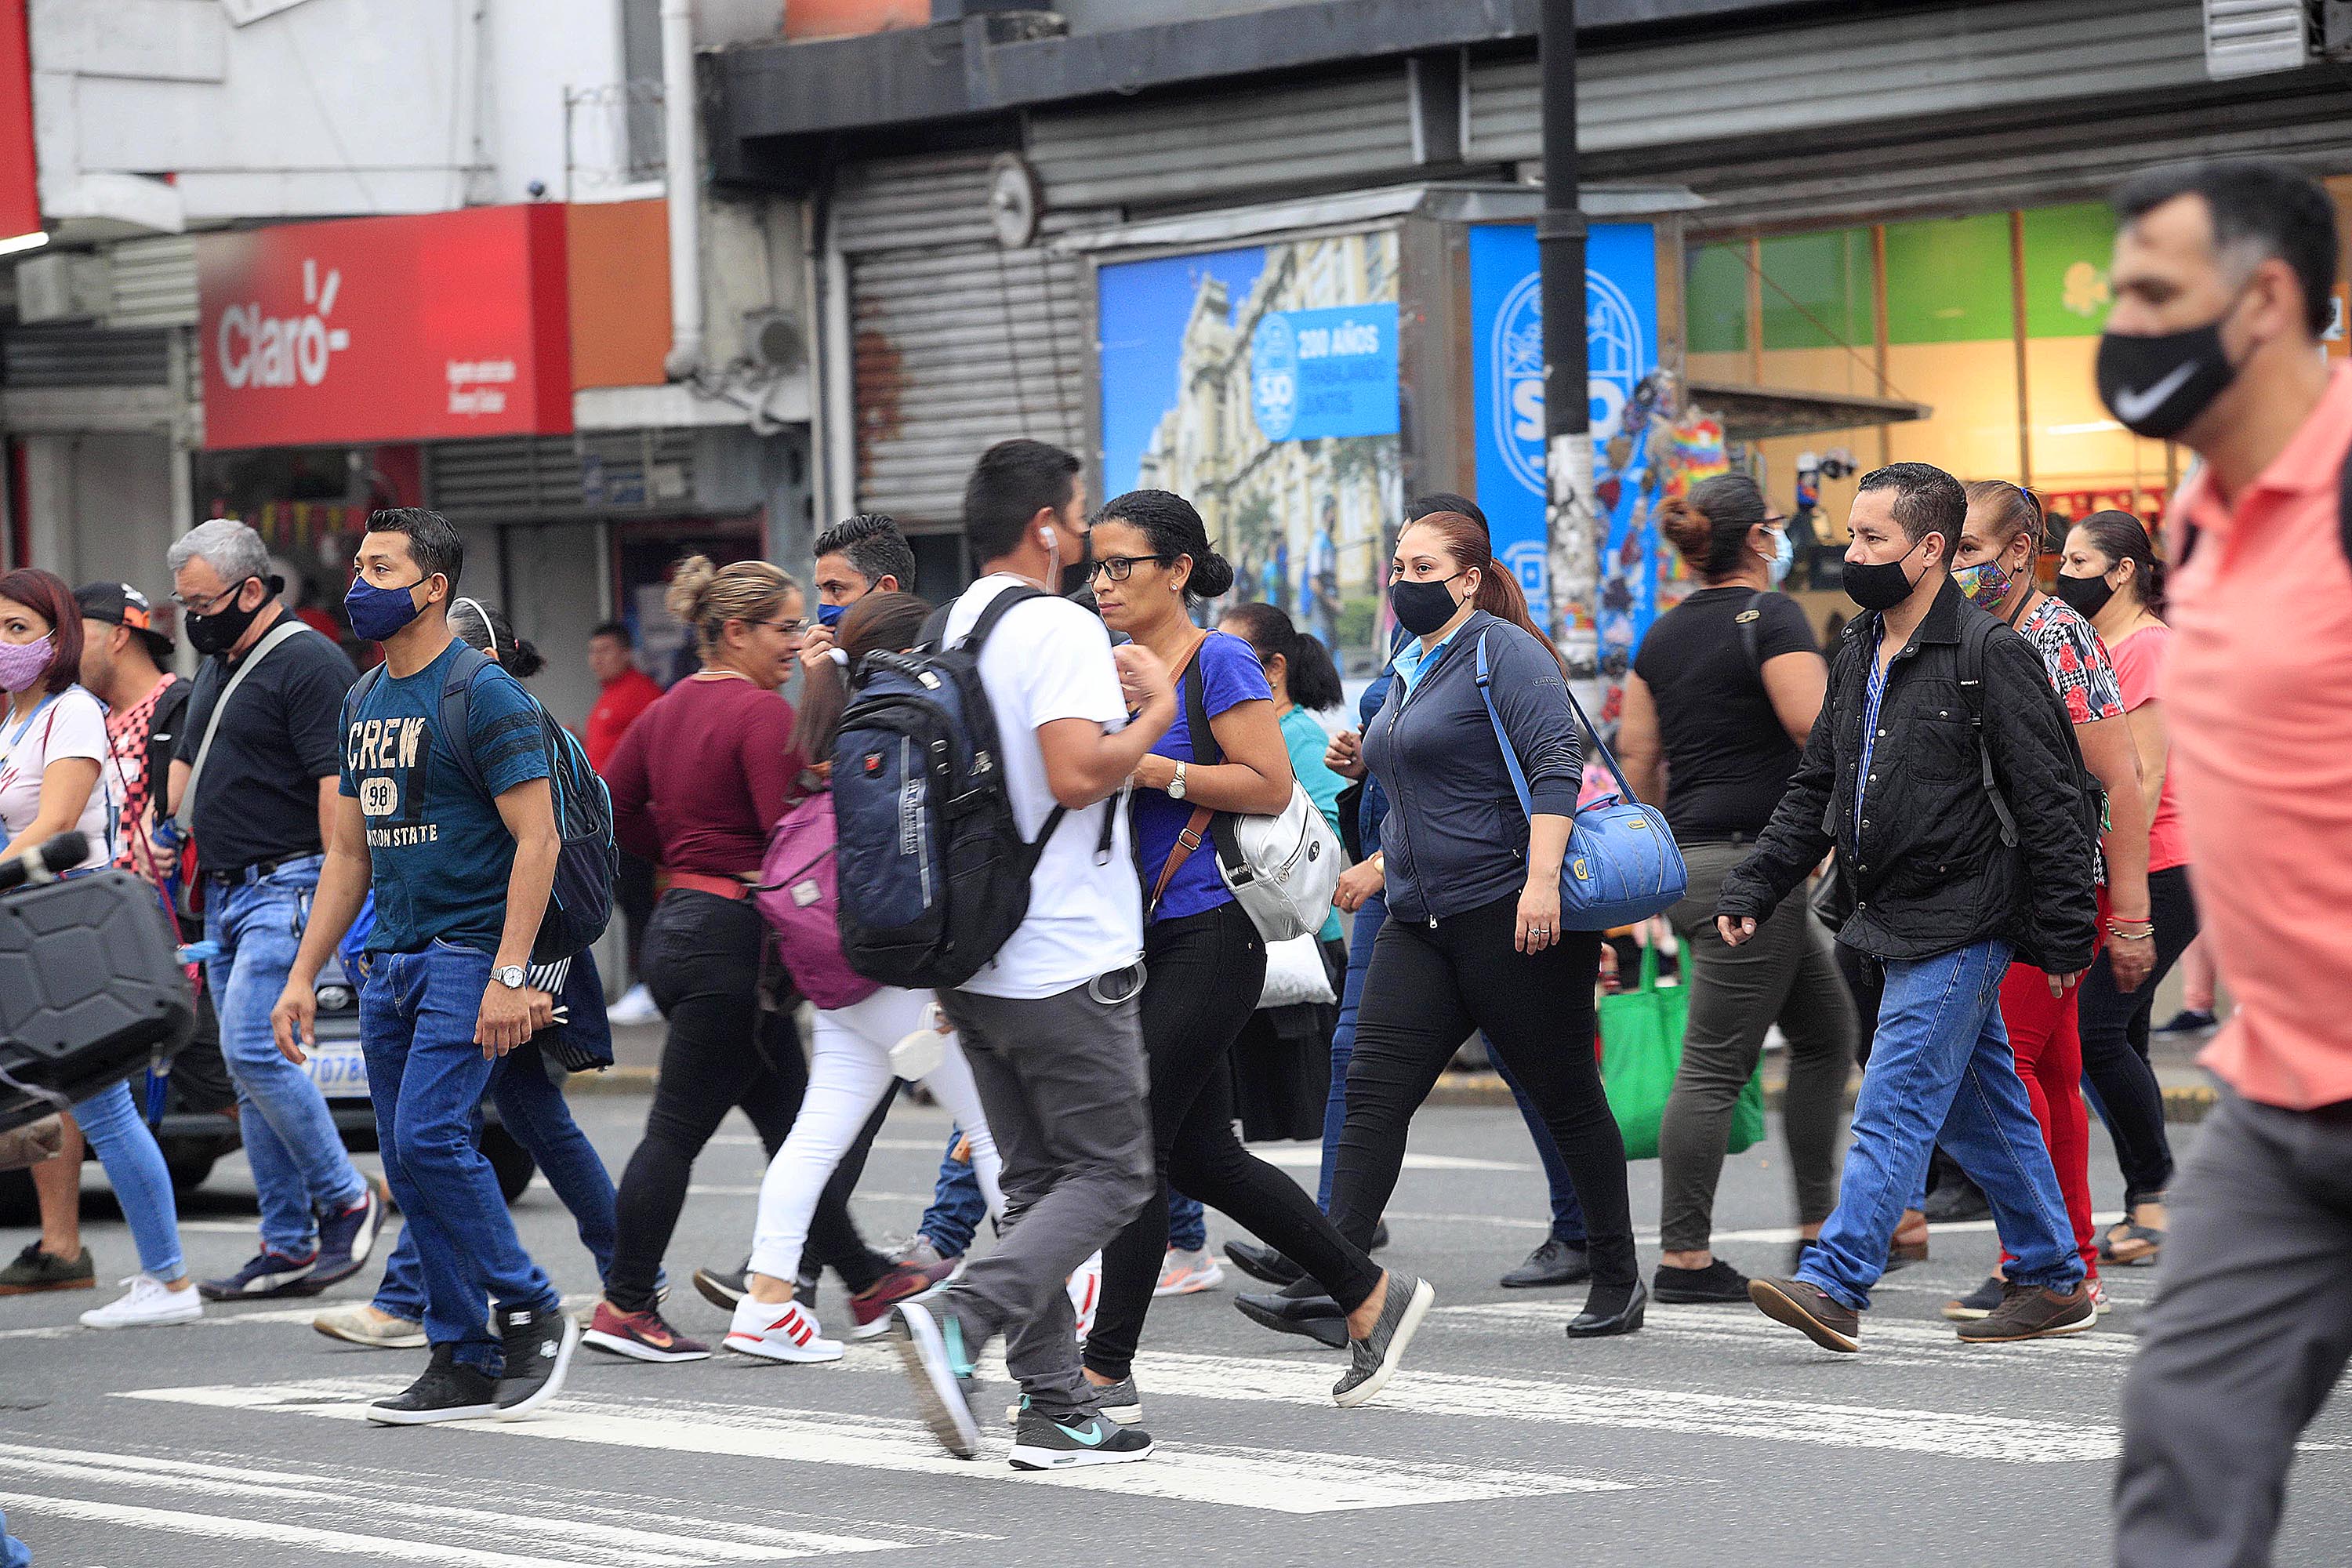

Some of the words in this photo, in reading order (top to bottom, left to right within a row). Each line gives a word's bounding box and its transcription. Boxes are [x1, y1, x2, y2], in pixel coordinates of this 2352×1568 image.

[219, 303, 328, 387] Claro
[1298, 329, 1328, 358] 200
[1332, 320, 1378, 354] AÑOS
[347, 717, 426, 771] CREW
[369, 786, 389, 807] 98
[394, 824, 438, 846] STATE
